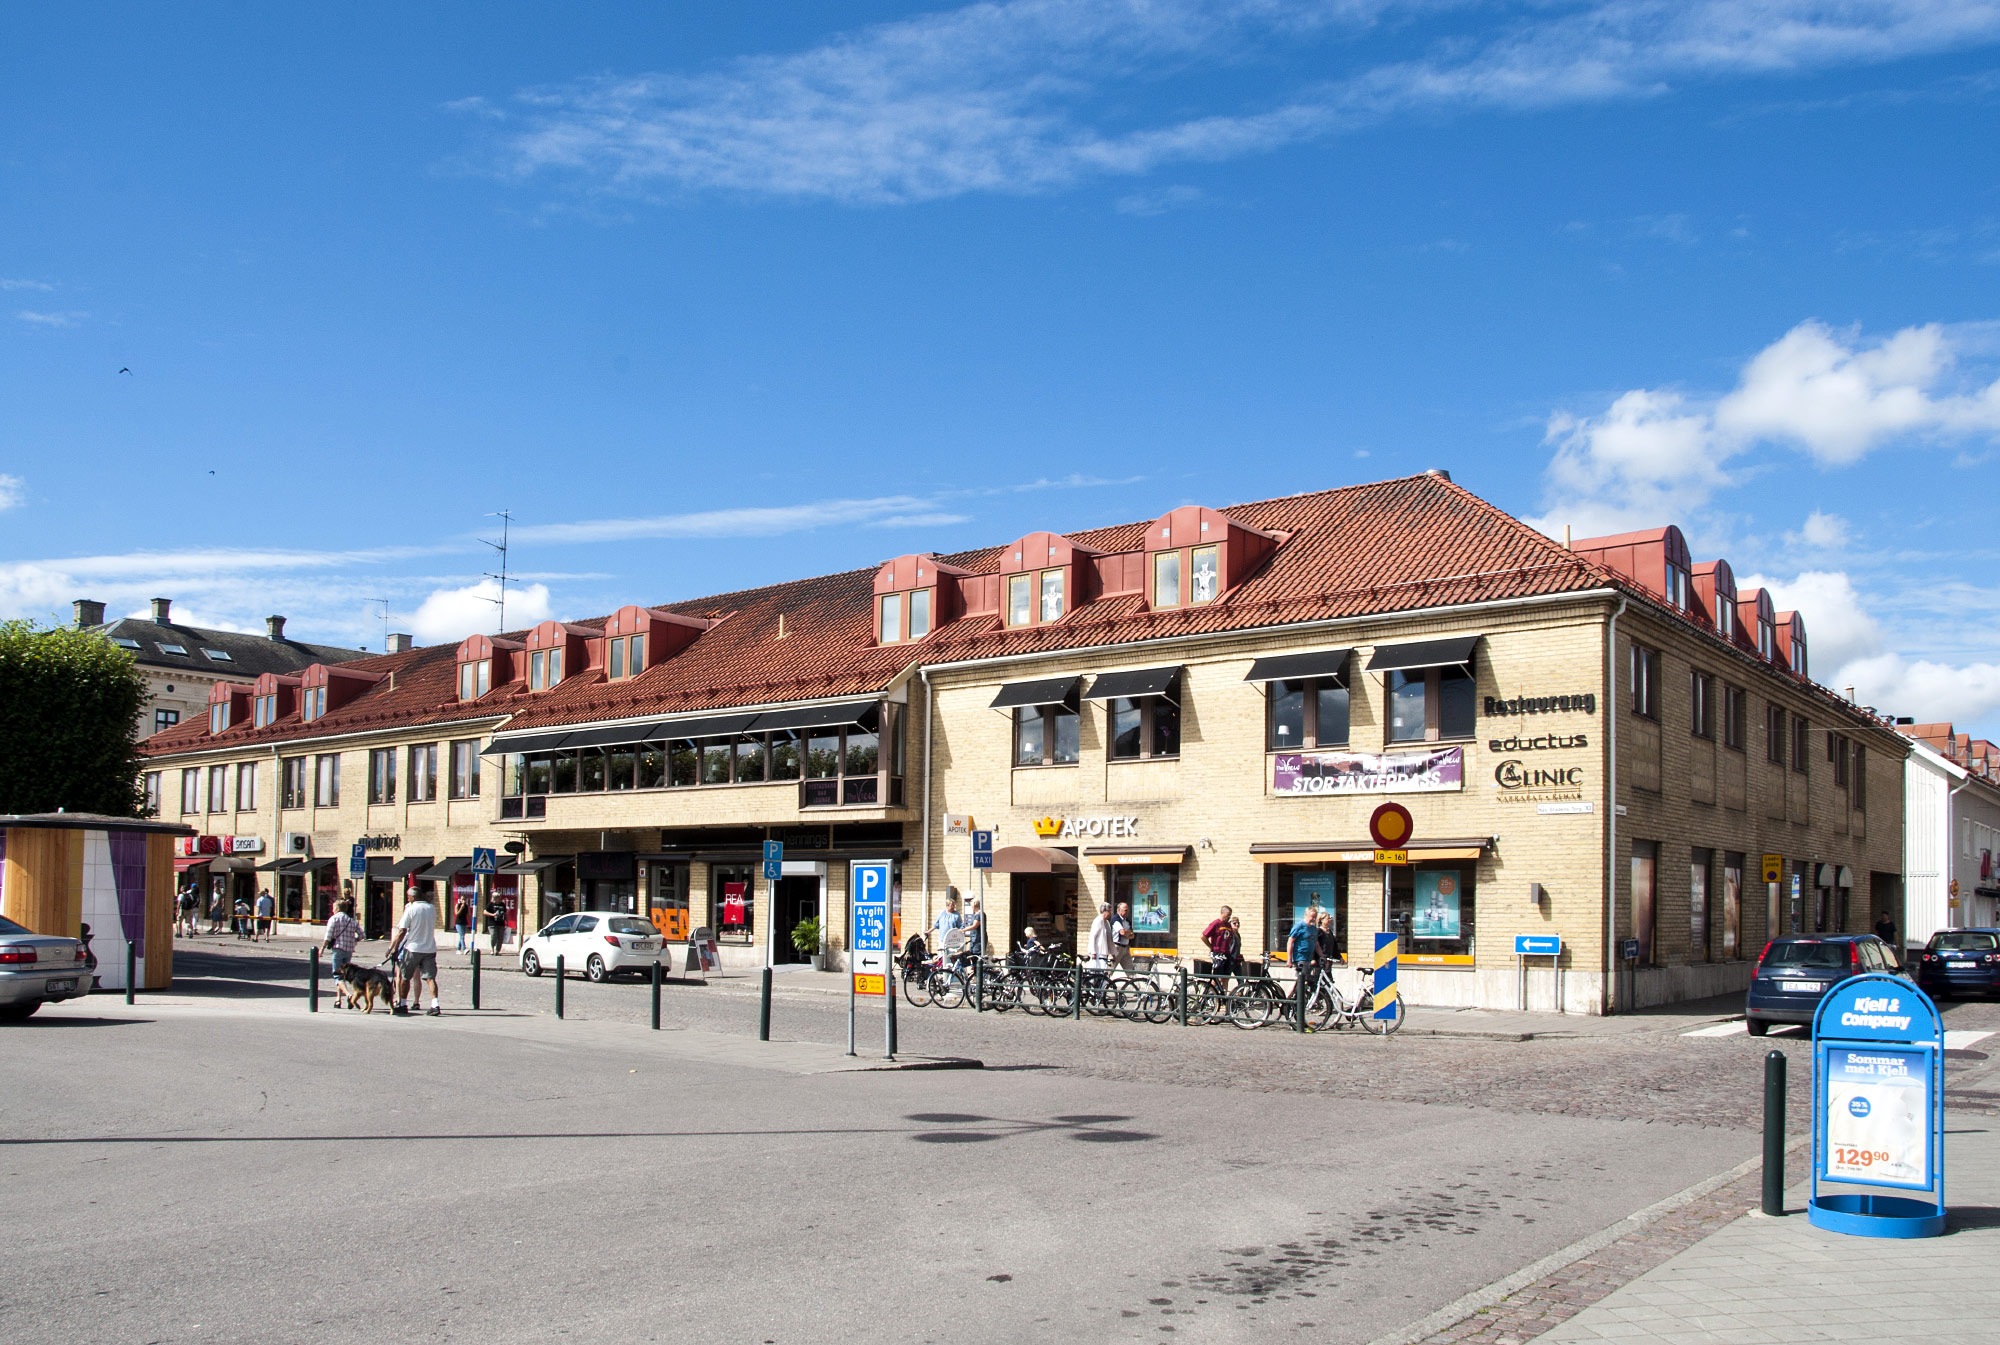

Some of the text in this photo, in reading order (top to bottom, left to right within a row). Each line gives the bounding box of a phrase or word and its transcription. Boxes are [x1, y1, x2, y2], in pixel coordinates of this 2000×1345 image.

[1484, 693, 1595, 715] Restaurang
[1489, 733, 1588, 752] eductus
[1281, 757, 1300, 772] View
[1495, 759, 1583, 790] CLINIC
[1292, 776, 1334, 792] STOR
[948, 826, 967, 834] APOTEK
[1063, 817, 1137, 836] APOTEK
[293, 836, 306, 850] g
[783, 829, 828, 848] hennings
[978, 832, 988, 849] P
[355, 845, 363, 857] P
[769, 843, 779, 858] P
[1353, 852, 1374, 861] APOT
[1376, 853, 1385, 862] (8
[1394, 853, 1406, 862] 16)
[975, 856, 991, 864] TAXI
[862, 869, 879, 900] P
[725, 893, 744, 905] REA
[857, 906, 883, 918] Avgift
[651, 908, 689, 941] REA
[860, 918, 866, 927] 3
[862, 928, 879, 938] 8-18
[858, 939, 881, 949] (8-14)
[1854, 997, 1900, 1013] Kjell &
[1841, 1012, 1911, 1031] Company
[1847, 1053, 1905, 1066] Sommar
[1845, 1064, 1908, 1077] med Kjell
